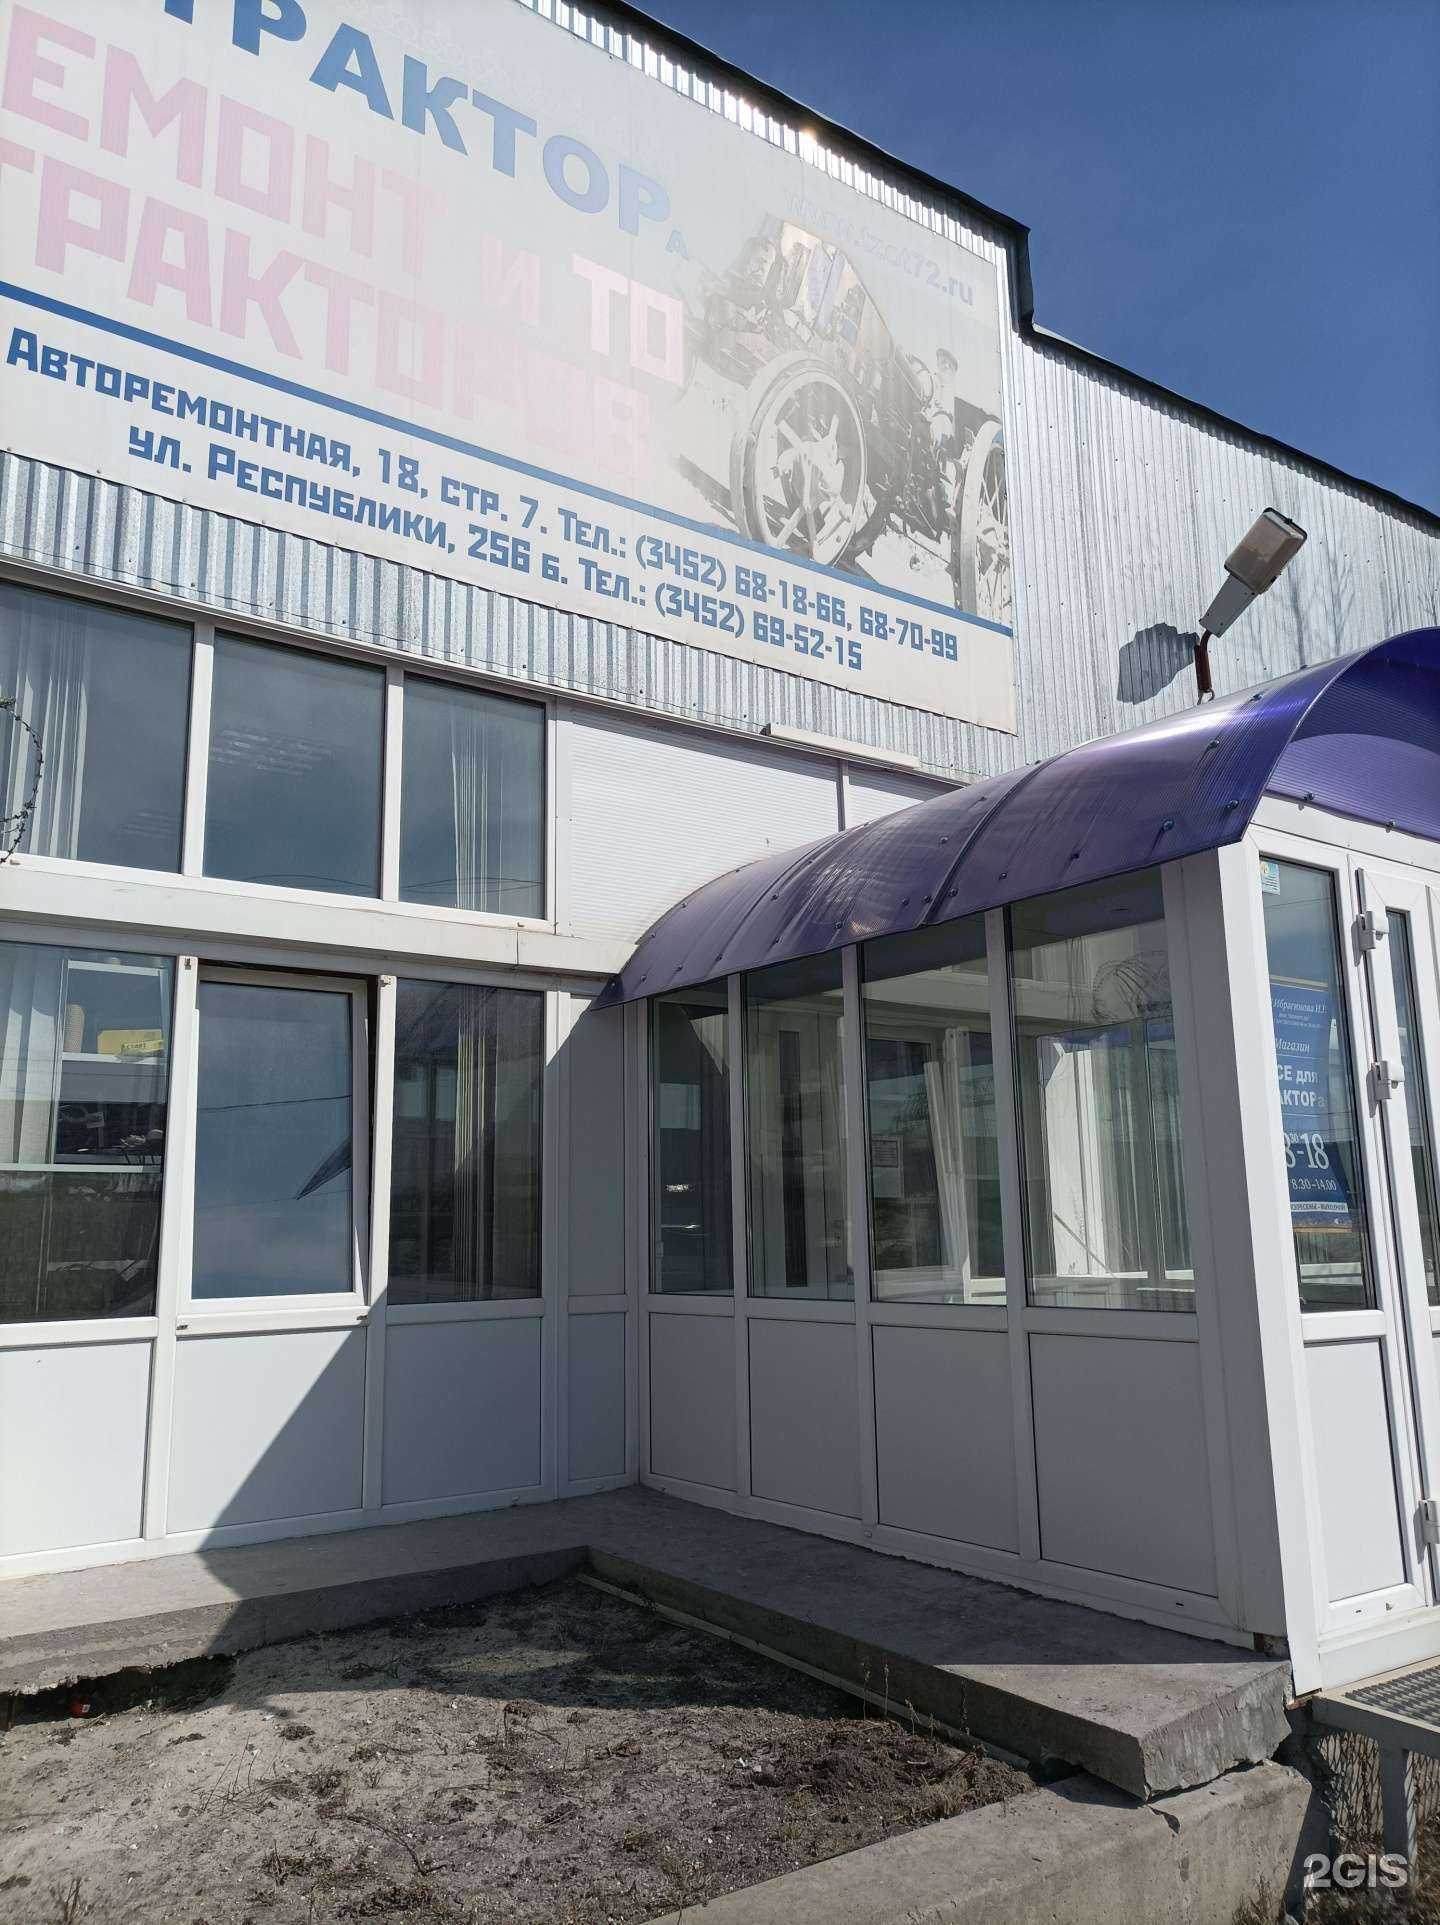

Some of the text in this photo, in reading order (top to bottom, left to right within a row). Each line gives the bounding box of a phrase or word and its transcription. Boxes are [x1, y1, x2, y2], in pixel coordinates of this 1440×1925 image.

[164, 0, 690, 262] РАКТОРА
[571, 253, 685, 385] ТО
[378, 448, 429, 499] 18,
[520, 495, 549, 535] 7.
[635, 534, 727, 593] (3452)
[735, 564, 853, 632] 68-18-66,
[859, 605, 959, 663] 68-70-99
[467, 524, 531, 575] 256
[655, 582, 745, 640] (3452)
[753, 610, 863, 671] 69-52-15
